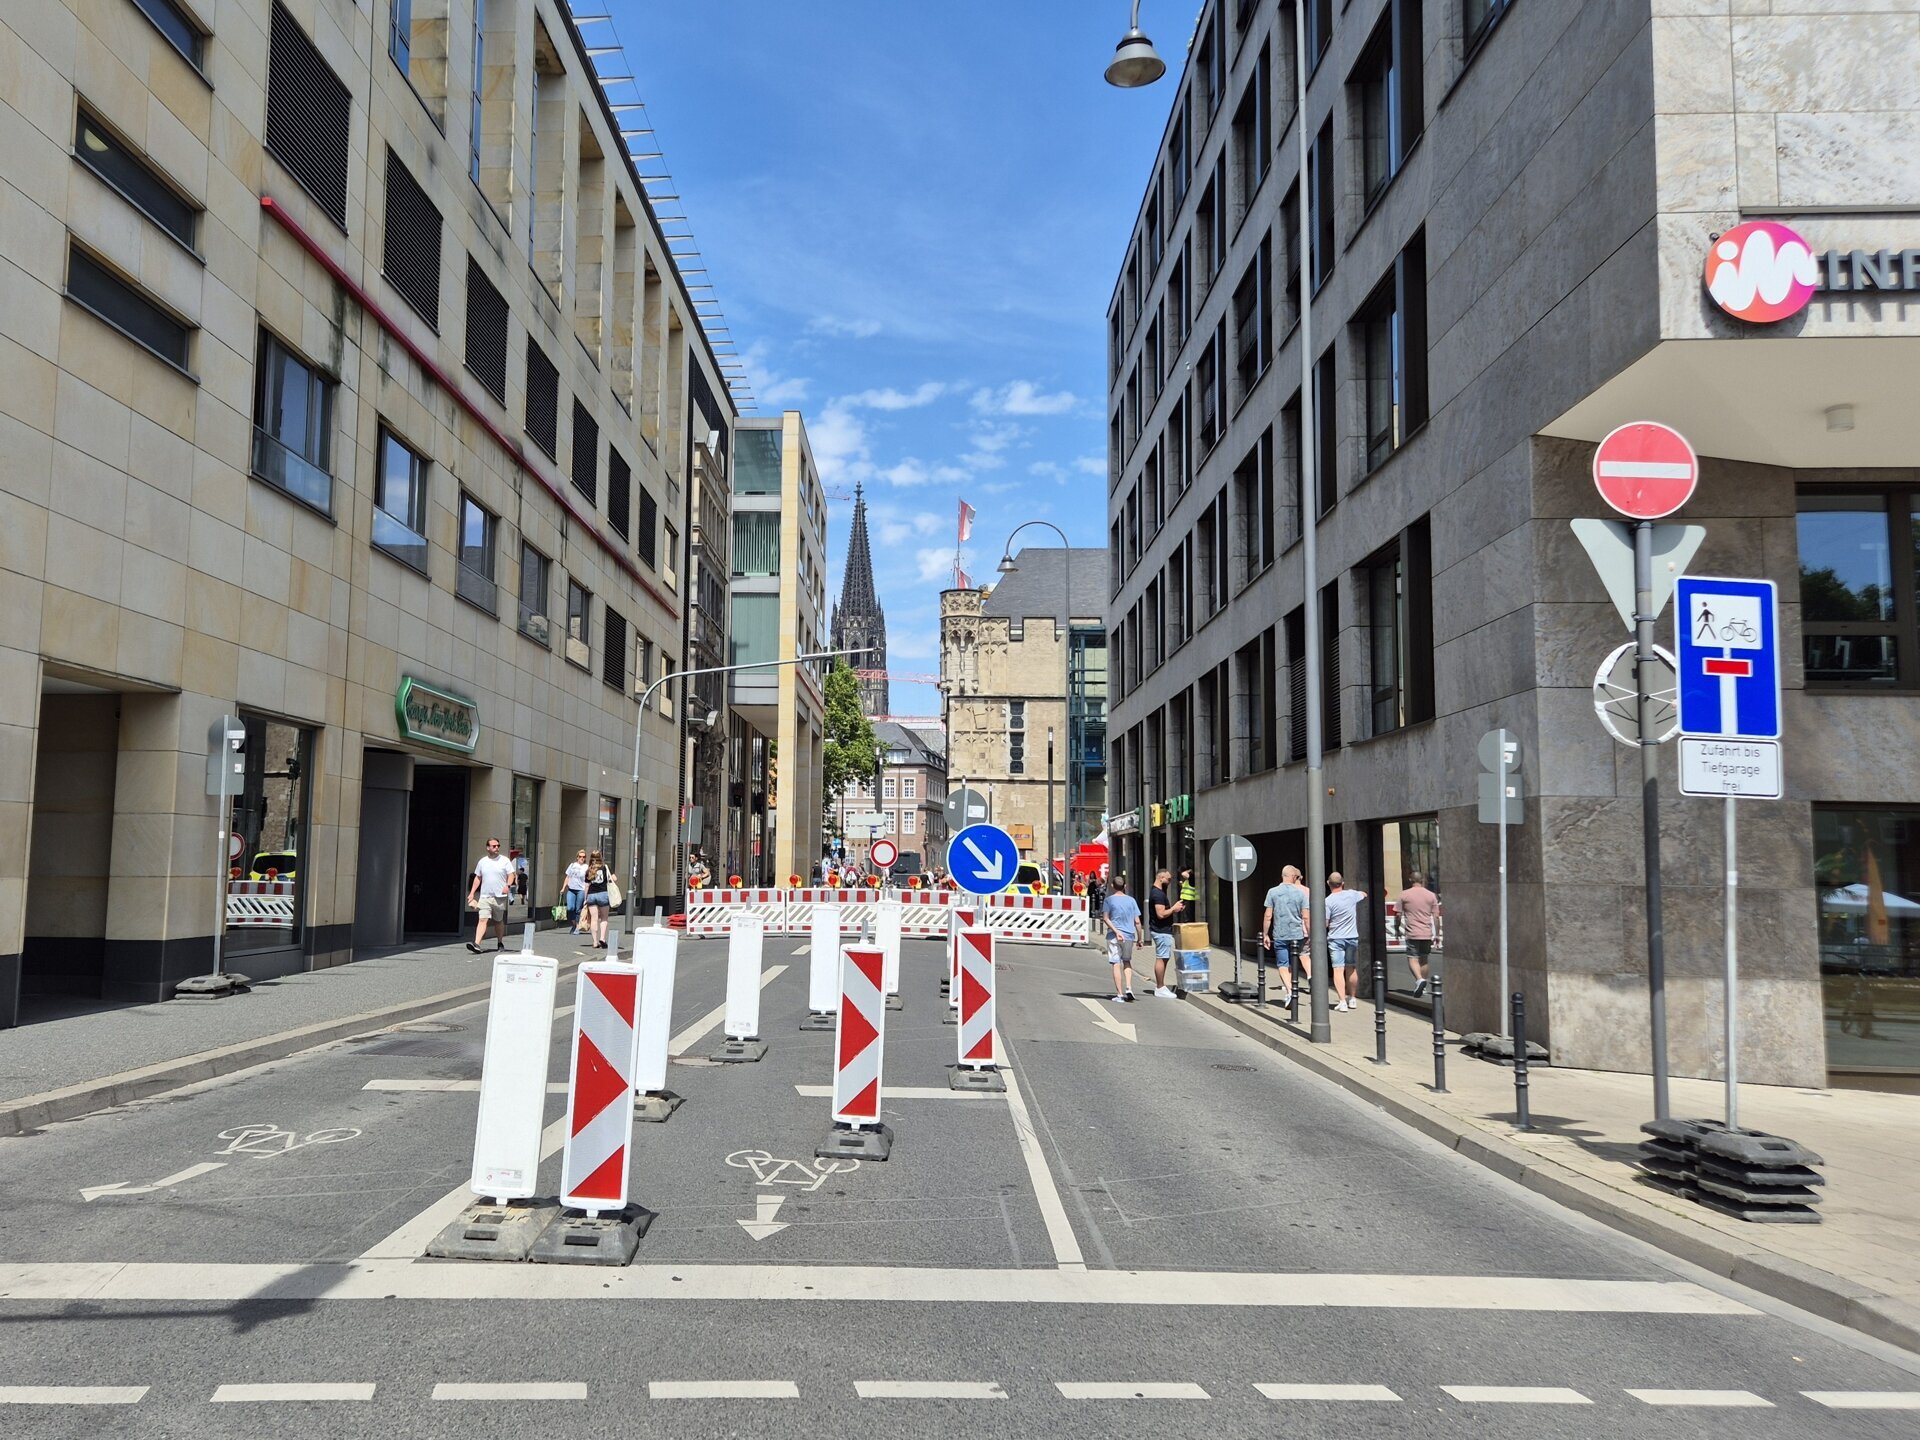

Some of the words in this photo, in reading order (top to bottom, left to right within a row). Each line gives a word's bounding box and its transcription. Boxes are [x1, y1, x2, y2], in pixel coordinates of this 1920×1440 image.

[1700, 743, 1741, 757] Zufahrt
[1744, 746, 1761, 757] bis
[1701, 760, 1761, 778] Tiefgarage
[1722, 779, 1741, 792] frei
